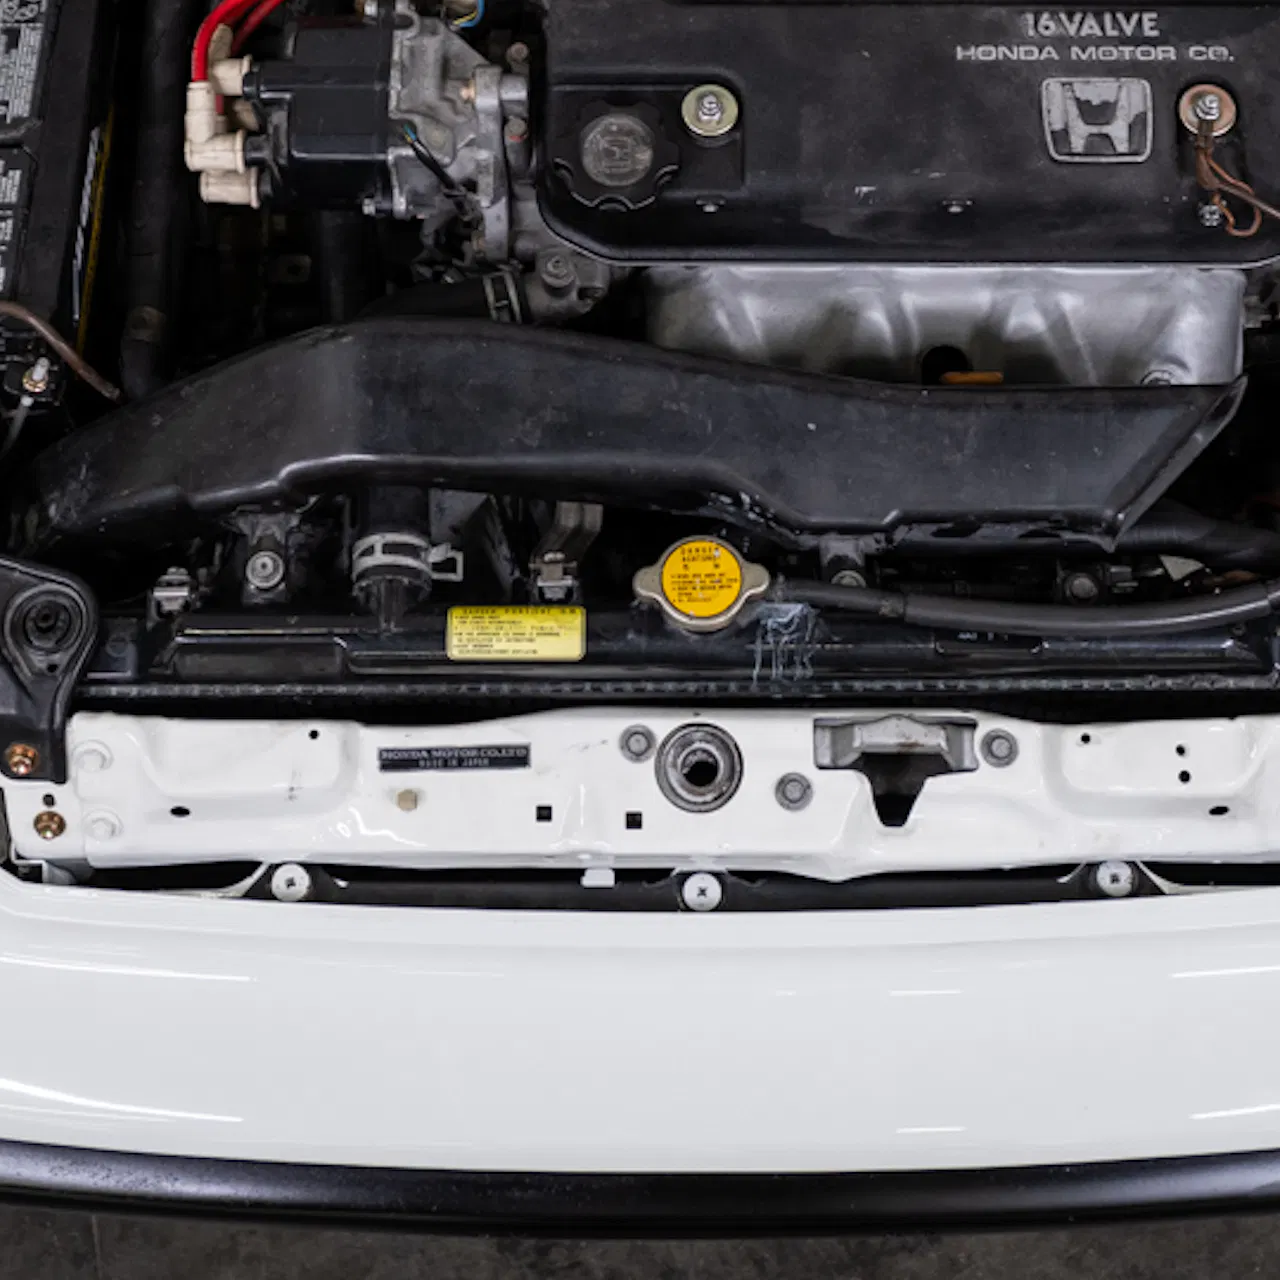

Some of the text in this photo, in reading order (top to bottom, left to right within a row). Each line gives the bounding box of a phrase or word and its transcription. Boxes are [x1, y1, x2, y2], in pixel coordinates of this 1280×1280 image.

[955, 45, 1235, 62] HONDA MOTOR CO.
